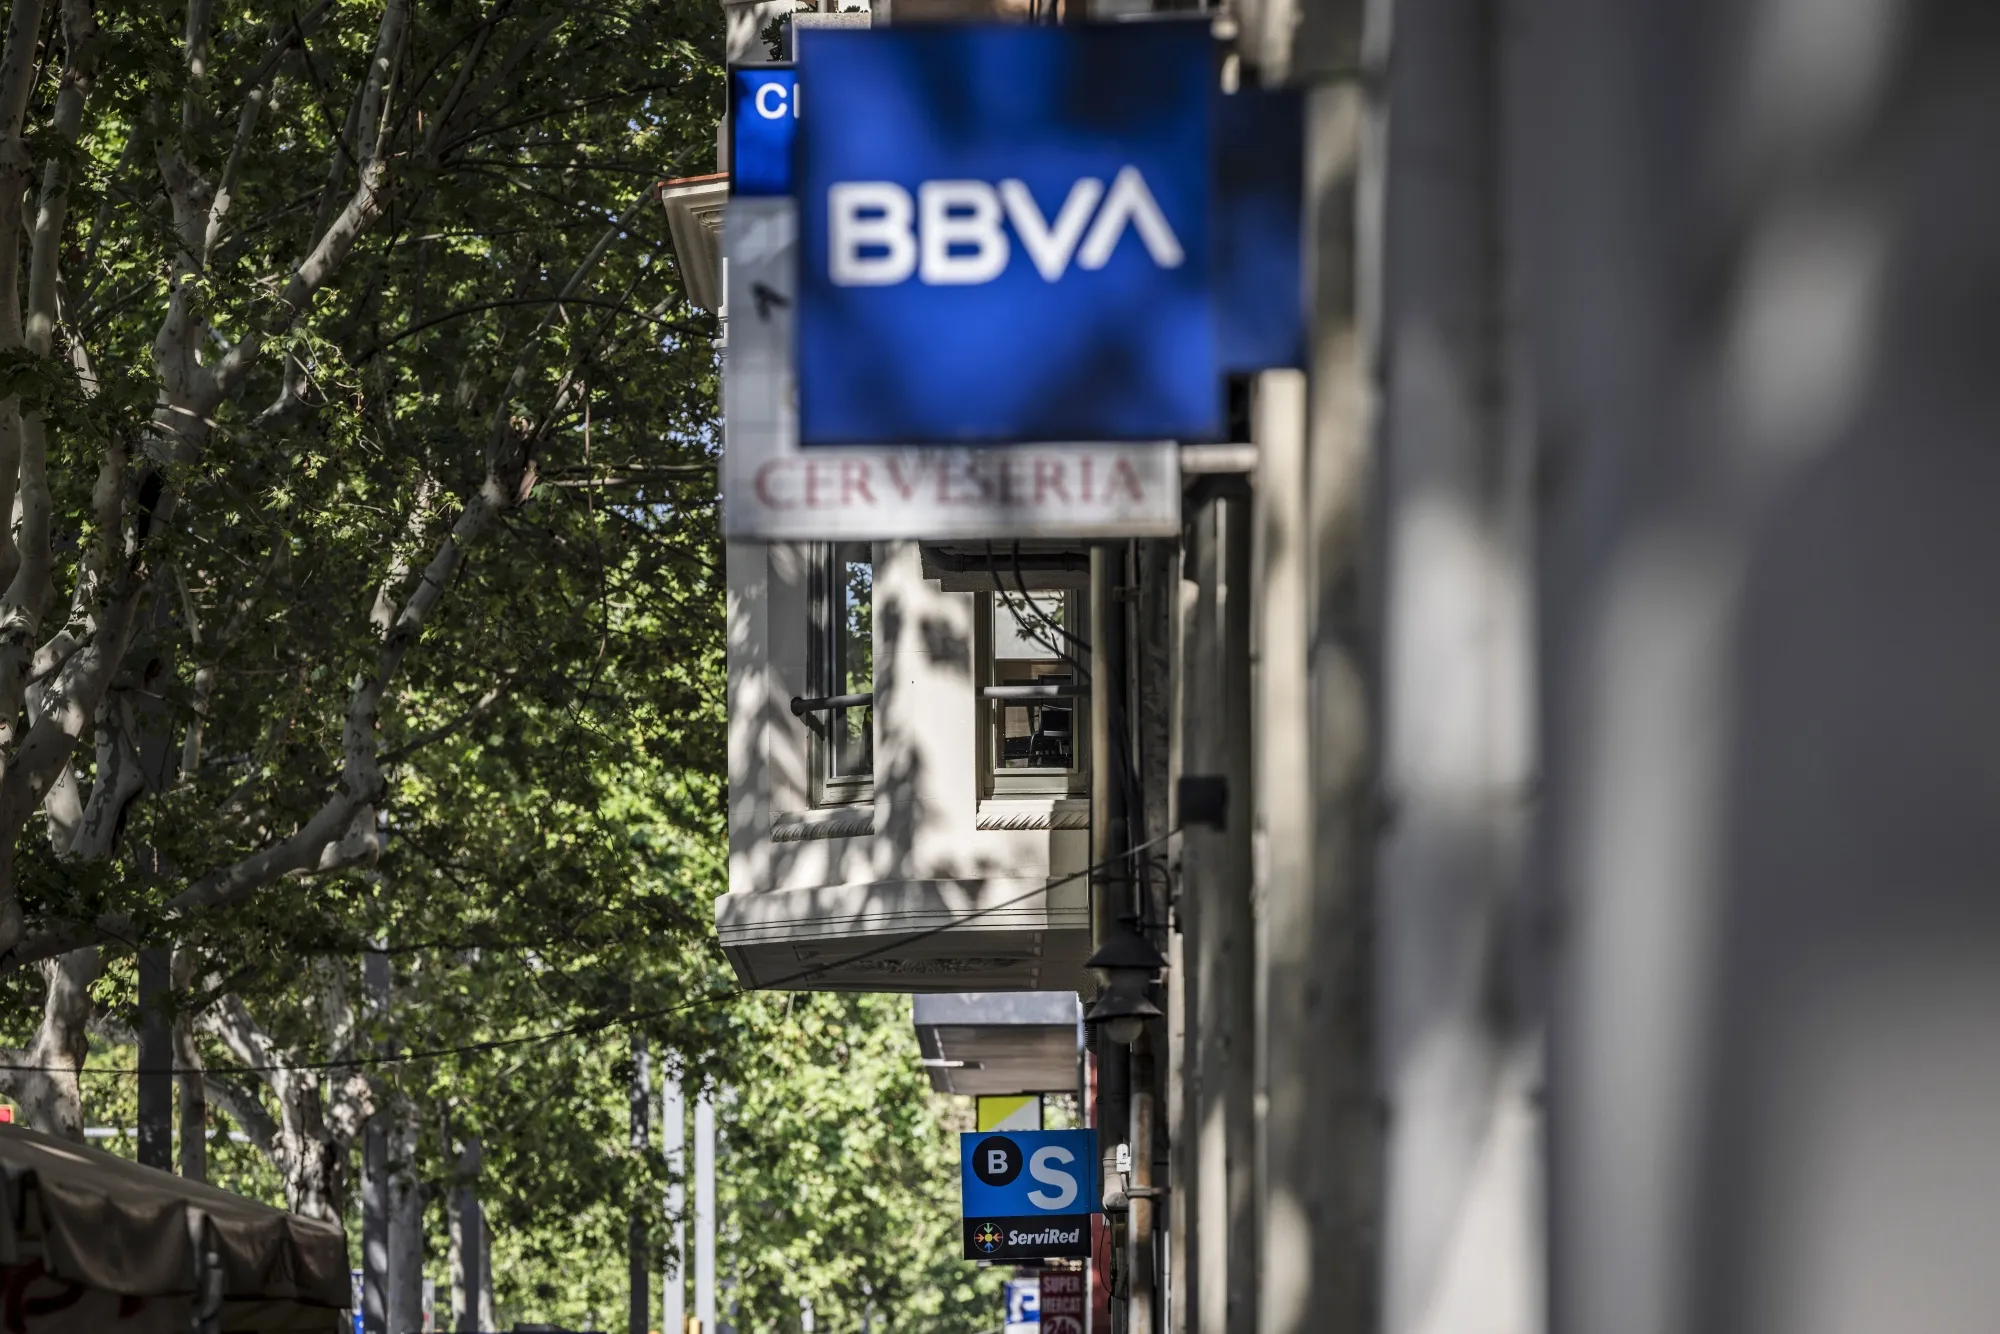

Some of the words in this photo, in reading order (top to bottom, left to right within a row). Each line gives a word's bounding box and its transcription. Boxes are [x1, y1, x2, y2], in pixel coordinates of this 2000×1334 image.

[827, 165, 1185, 286] BBVA
[987, 1150, 1009, 1175] B
[1027, 1146, 1078, 1210] S
[1008, 1228, 1080, 1246] ServiRed
[1043, 1276, 1081, 1293] SUPER
